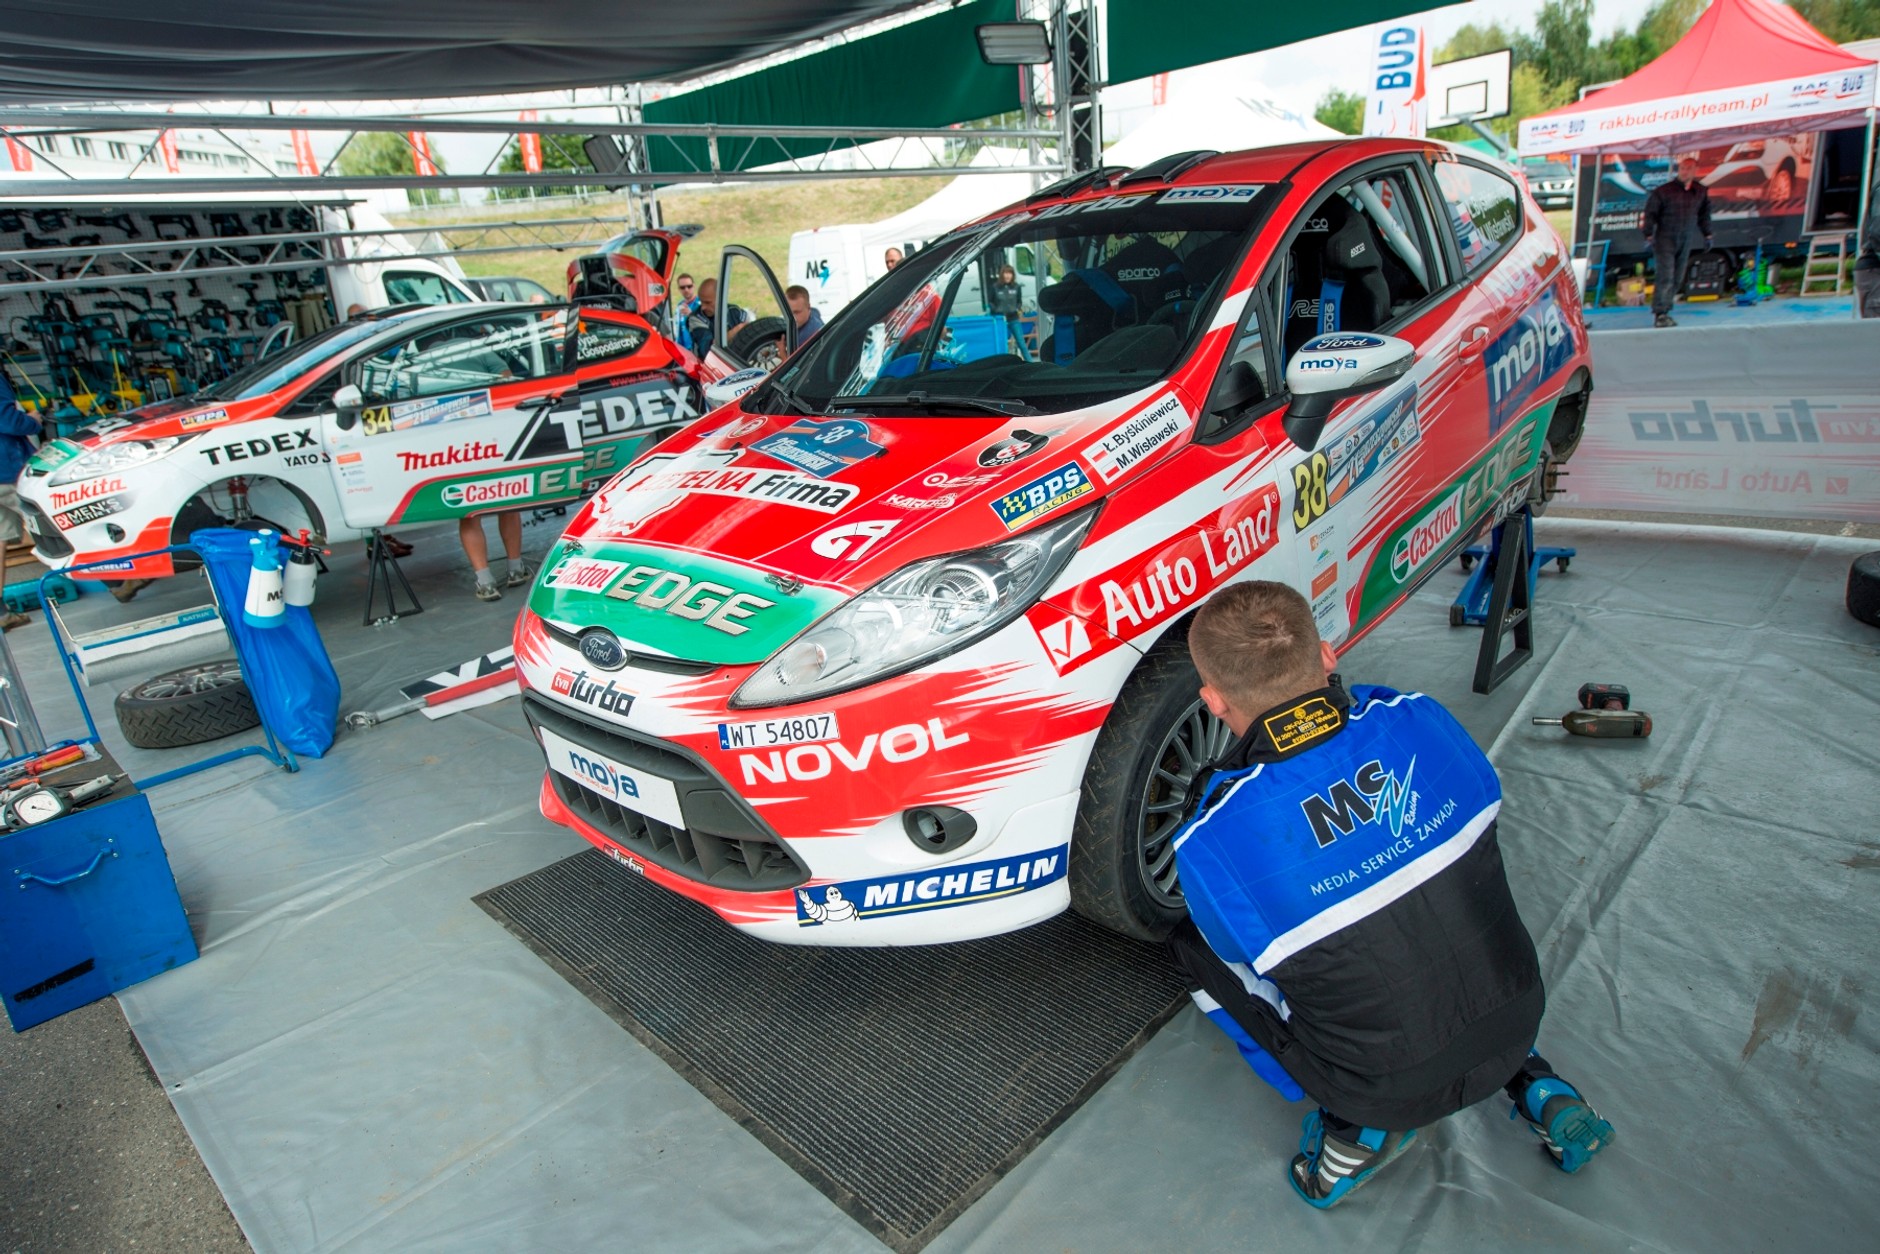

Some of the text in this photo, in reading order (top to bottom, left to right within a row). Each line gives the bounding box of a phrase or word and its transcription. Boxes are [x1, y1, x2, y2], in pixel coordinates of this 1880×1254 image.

[1792, 74, 1865, 93] RAK BUD
[1599, 93, 1769, 132] rakbud-rallyteam.pl
[1168, 185, 1258, 200] moya
[1117, 267, 1161, 282] sparco
[1316, 338, 1368, 350] Ford
[1493, 303, 1565, 404] moya
[1300, 356, 1357, 374] moya
[361, 406, 394, 436] 34
[814, 425, 855, 444] 38
[199, 427, 319, 466] TEDEX
[284, 453, 319, 468] YATO
[396, 441, 505, 472] makita
[1115, 418, 1180, 469] M.Wisławski
[49, 476, 128, 511] makita
[465, 477, 530, 504] Castrol
[748, 473, 851, 509] Firma
[1027, 465, 1081, 509] BPS
[1032, 487, 1084, 518] RACING
[1293, 452, 1329, 531] 38
[1408, 418, 1538, 567] Castrol EDGE
[1098, 493, 1273, 640] Auto Land
[557, 560, 779, 637] Castrol EDGE
[585, 636, 612, 663] Ford
[553, 670, 637, 718] tvn turbo
[729, 723, 757, 748] WT
[765, 716, 831, 745] 54807
[738, 717, 971, 786] NOVOL
[568, 750, 641, 801] moya
[1404, 790, 1421, 827] Racing
[1309, 797, 1459, 896] MEDIA SERVICE ZAWADA
[862, 854, 1060, 908] MICHELIN
